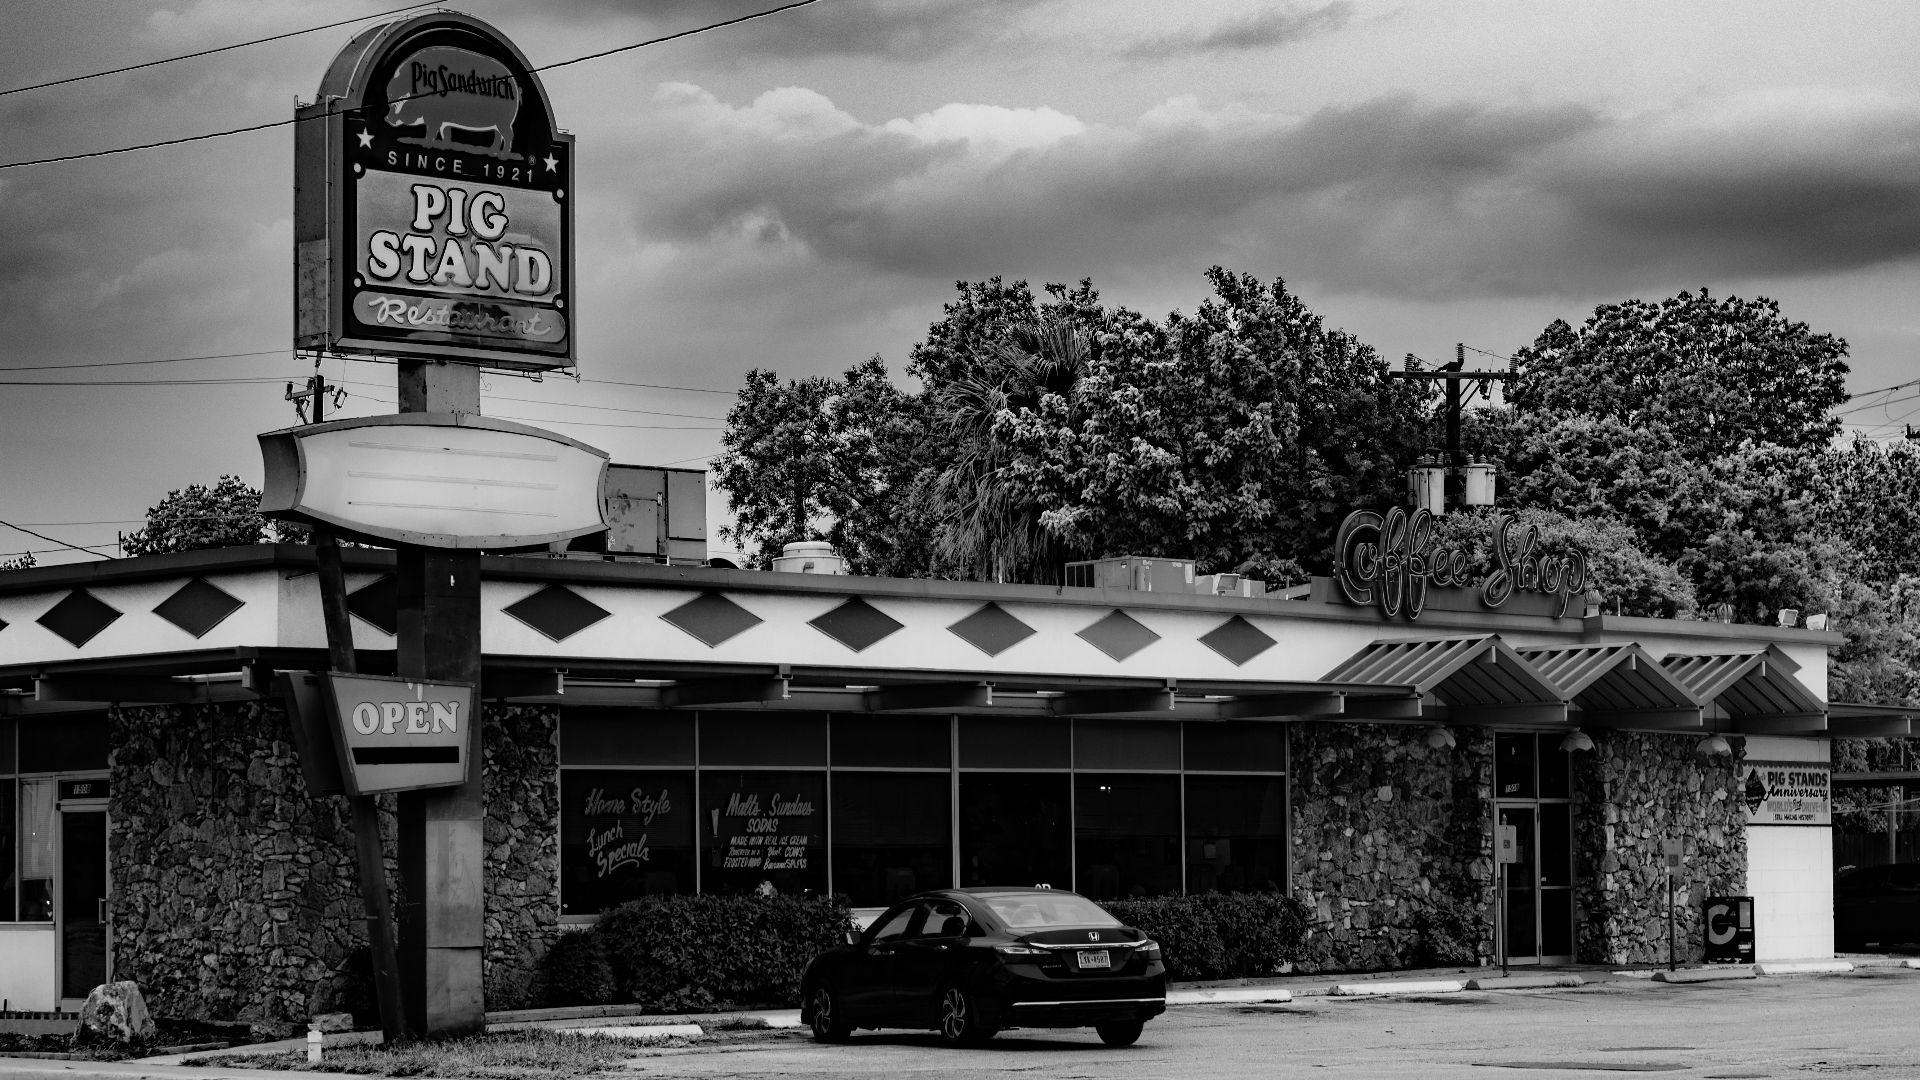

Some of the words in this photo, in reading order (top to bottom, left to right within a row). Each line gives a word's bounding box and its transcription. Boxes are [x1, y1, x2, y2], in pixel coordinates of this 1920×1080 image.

[410, 61, 438, 93] Pig
[438, 64, 515, 100] Sandwich
[388, 151, 463, 174] SINCE
[483, 163, 533, 183] 1921
[411, 184, 509, 241] PIG
[368, 230, 553, 296] STAND
[368, 296, 551, 336] Restaurant
[1335, 505, 1468, 619] Coffee
[1480, 514, 1585, 619] Shop
[352, 701, 460, 735] OPEN
[1762, 784, 1828, 802] Anniversary
[1767, 771, 1786, 786] PIG
[1788, 772, 1828, 787] STANDS
[585, 787, 626, 816] Home
[631, 787, 672, 826] Style
[769, 792, 816, 817] Sundaes
[587, 819, 623, 858] Lunch
[730, 835, 748, 846] MADE
[764, 835, 778, 846] REAL
[778, 835, 790, 846] ICE
[790, 835, 808, 846] CREAM
[746, 818, 779, 833] SODAS
[597, 833, 650, 878] Specials
[784, 846, 805, 858] COWS
